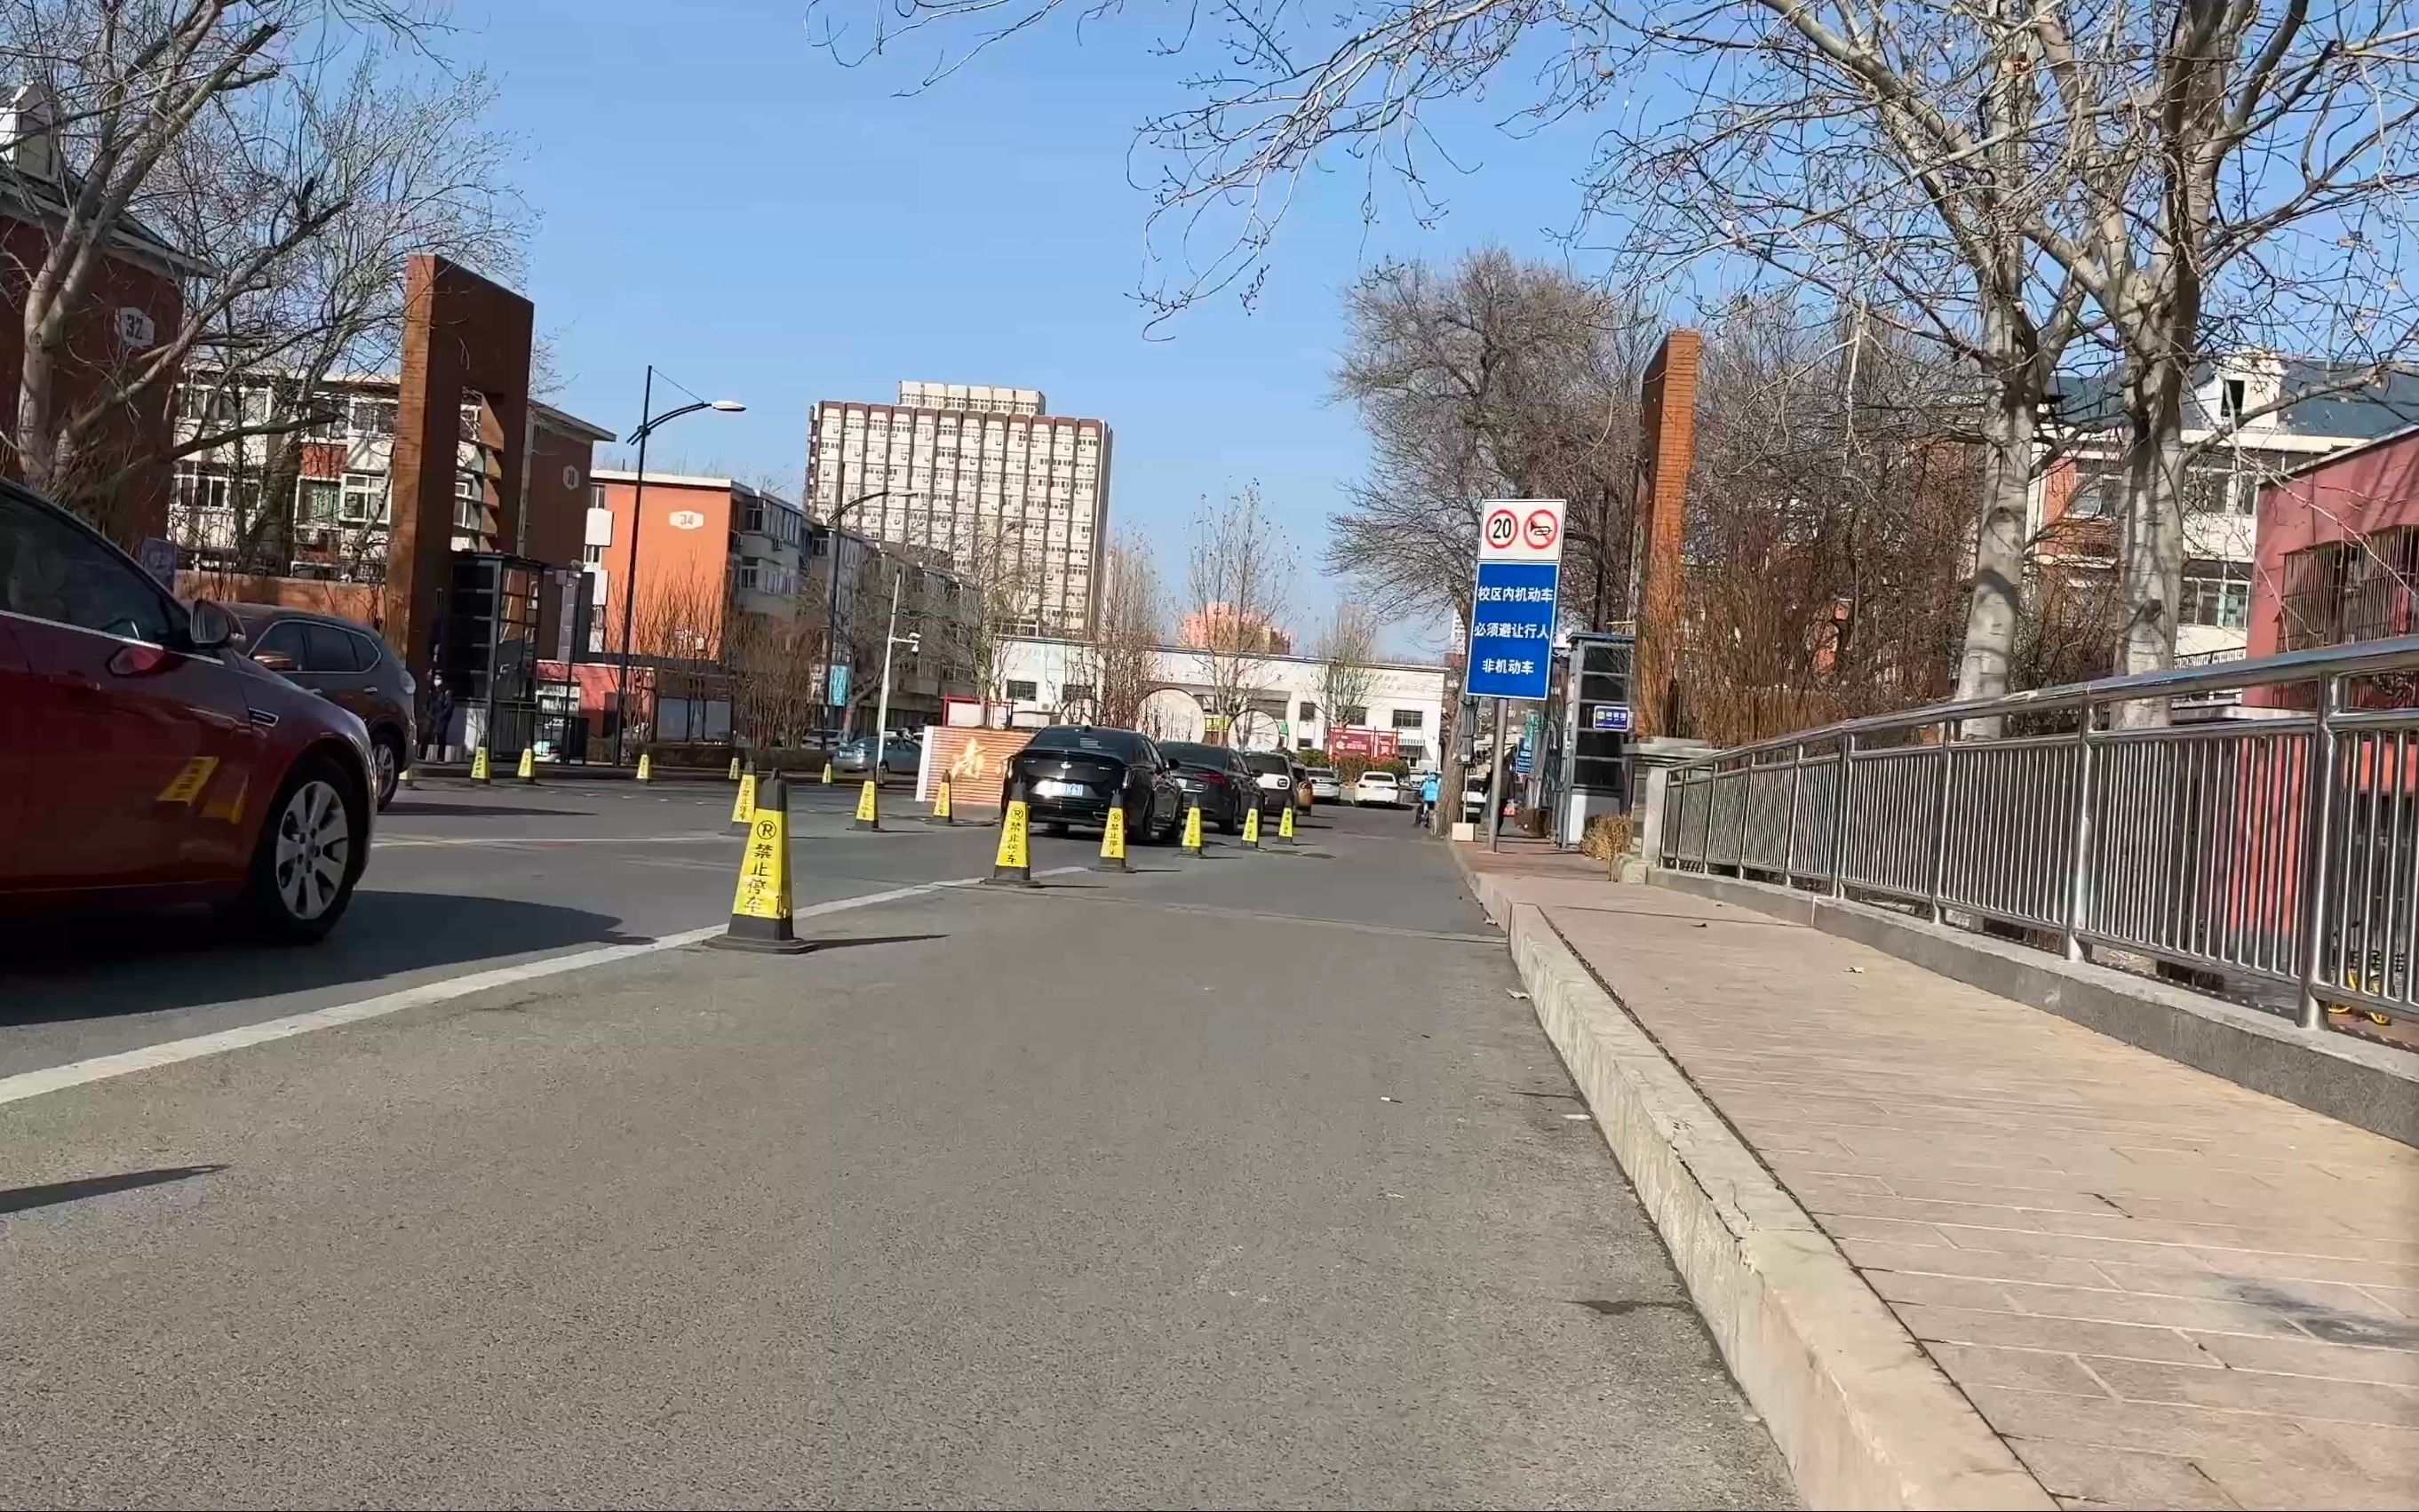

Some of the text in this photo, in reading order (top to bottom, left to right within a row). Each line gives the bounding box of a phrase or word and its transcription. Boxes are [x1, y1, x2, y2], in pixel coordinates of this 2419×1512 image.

[126, 314, 143, 339] 32
[1492, 517, 1512, 539] 20
[1477, 585, 1554, 603] 校区内机动车
[1474, 622, 1550, 640] 必须避让行人
[1481, 658, 1535, 675] 非机动车
[744, 842, 774, 913] 禁止停车
